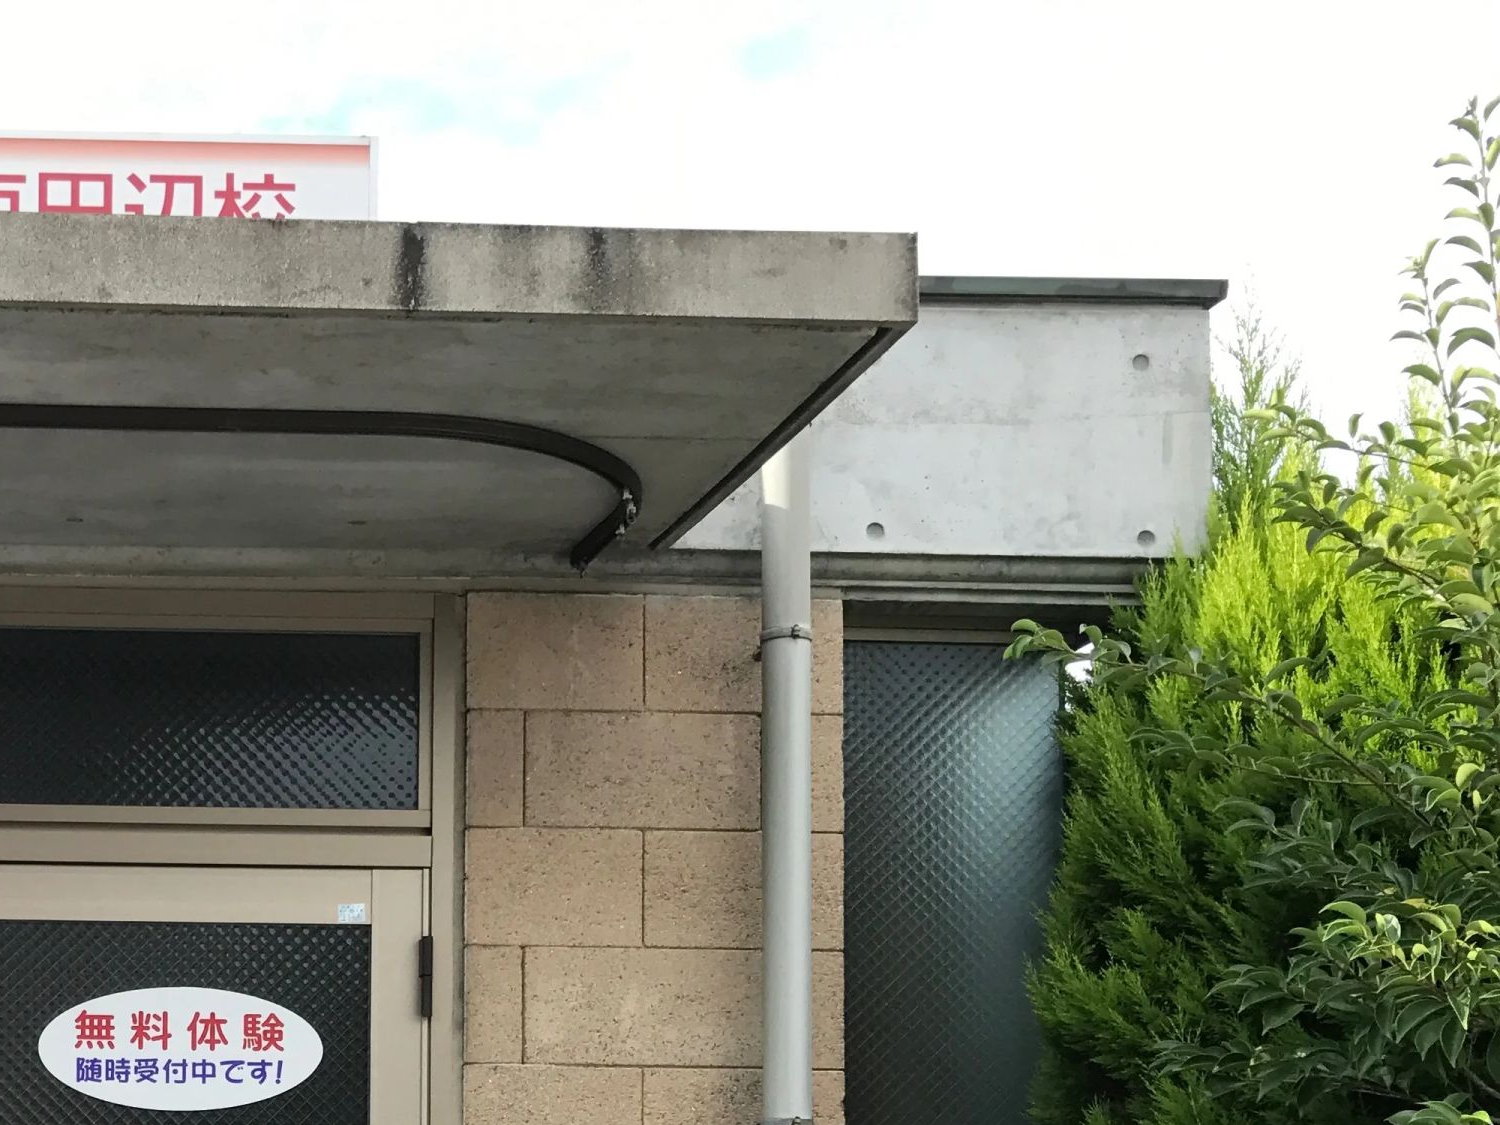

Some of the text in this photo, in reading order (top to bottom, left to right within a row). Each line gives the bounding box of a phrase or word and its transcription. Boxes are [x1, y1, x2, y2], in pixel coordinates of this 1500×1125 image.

[75, 1010, 285, 1053] 無料体験
[76, 1057, 283, 1085] 随時受付中です!
